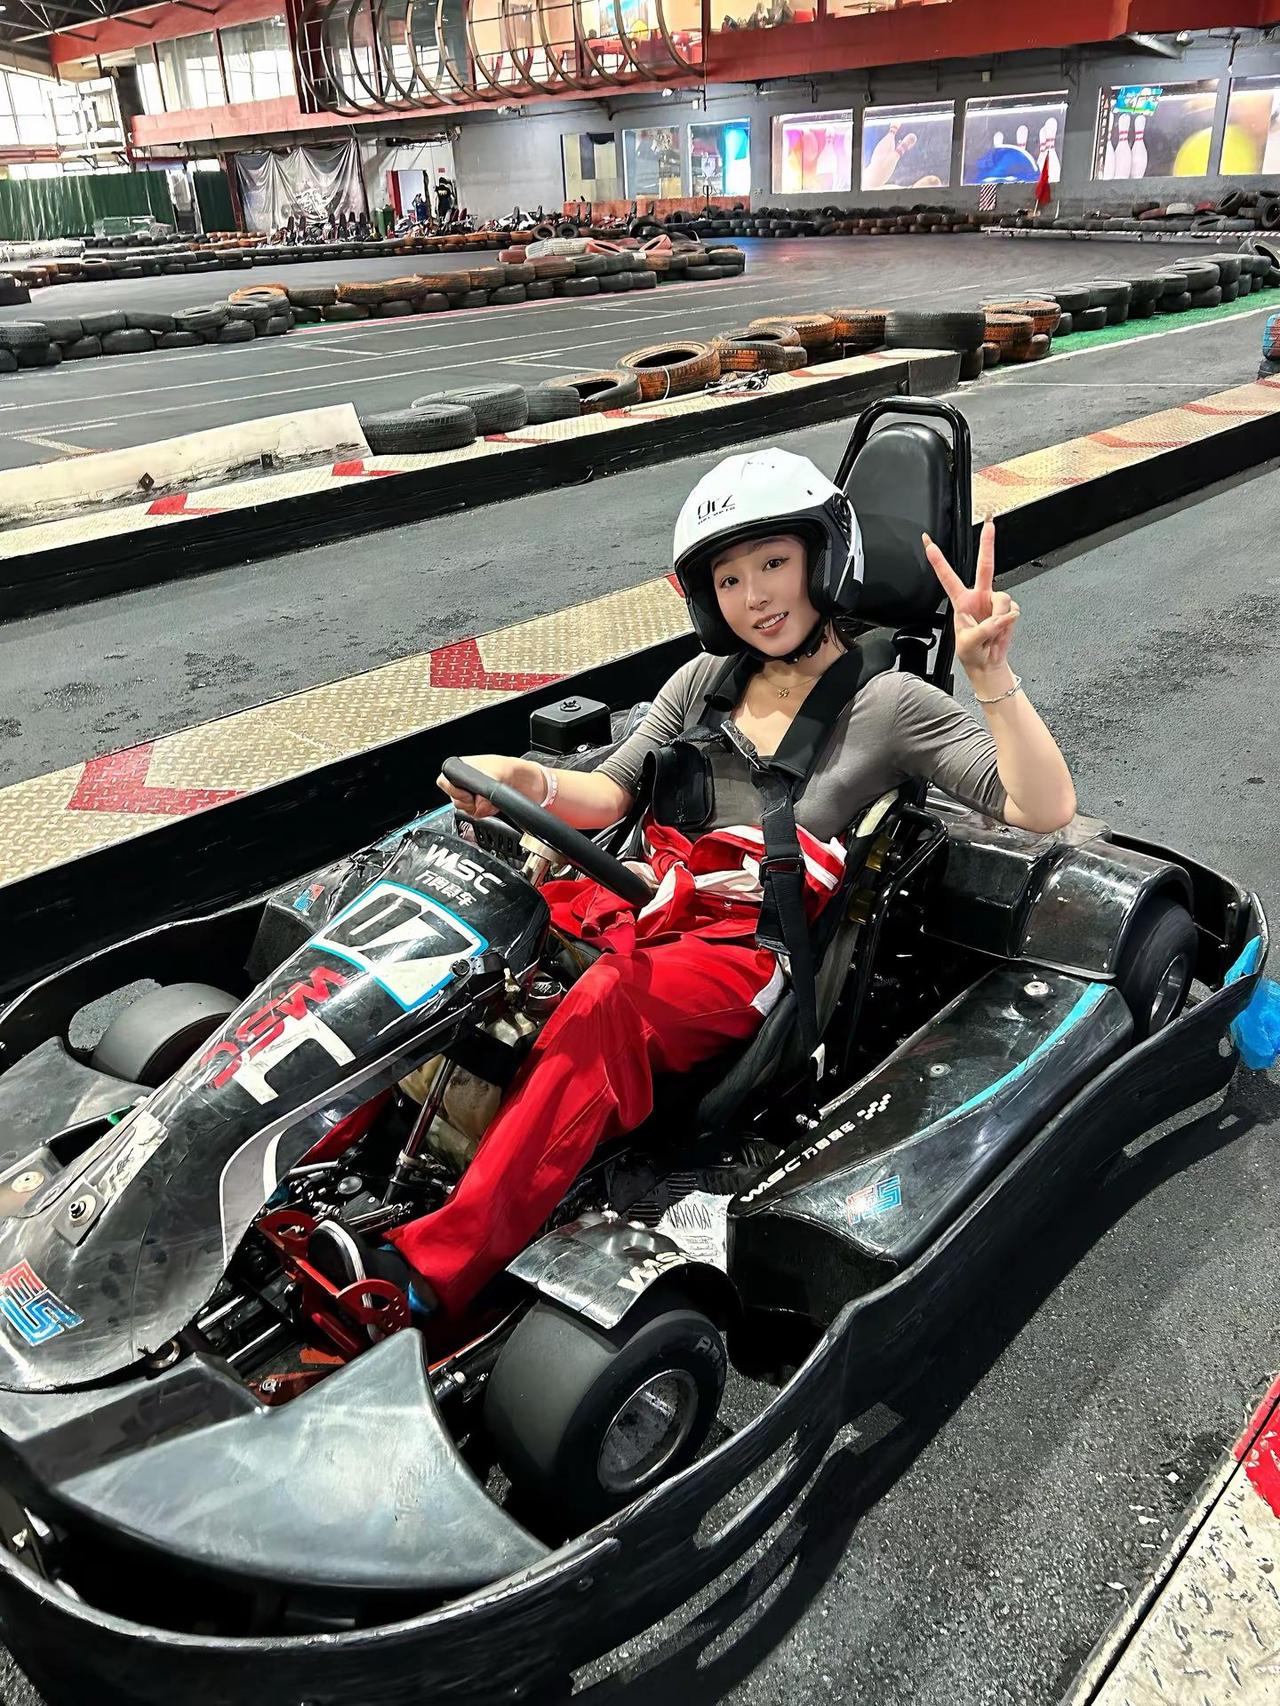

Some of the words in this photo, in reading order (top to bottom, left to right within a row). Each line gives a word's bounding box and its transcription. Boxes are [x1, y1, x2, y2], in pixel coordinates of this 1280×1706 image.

[424, 844, 503, 895] WSC
[740, 1156, 801, 1202] WSC
[617, 1251, 698, 1294] WS
